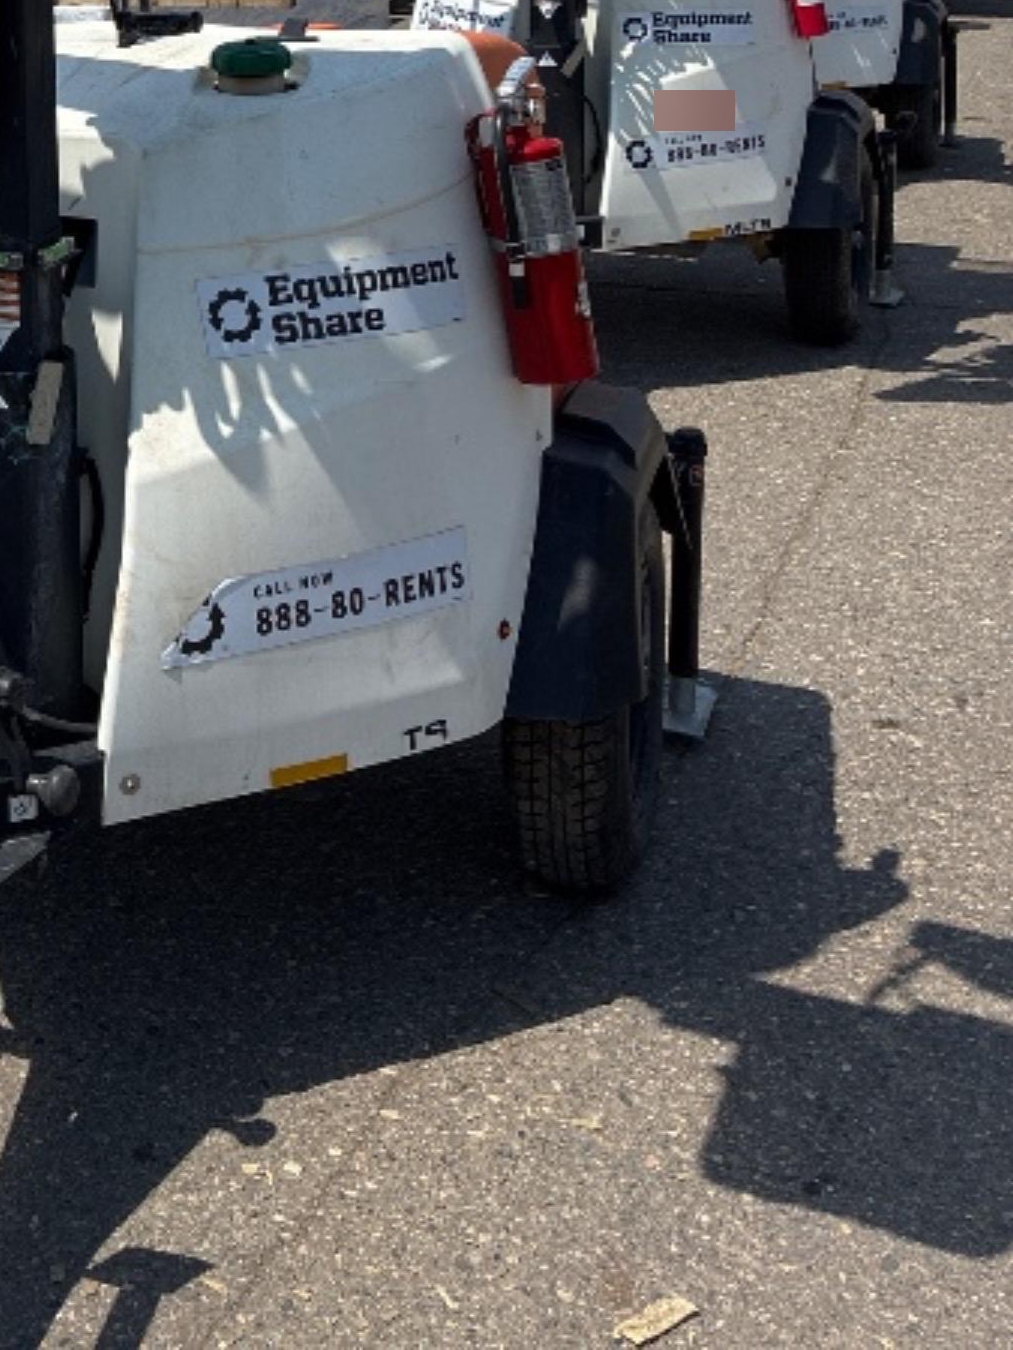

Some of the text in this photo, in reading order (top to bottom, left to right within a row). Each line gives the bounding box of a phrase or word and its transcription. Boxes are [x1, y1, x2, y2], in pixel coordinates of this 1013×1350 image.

[651, 11, 753, 30] Equipment
[652, 29, 712, 45] Share
[264, 251, 460, 309] Equipment
[271, 308, 386, 345] Share
[253, 569, 334, 600] CALL NOW
[255, 559, 466, 637] 888-80-RENTS
